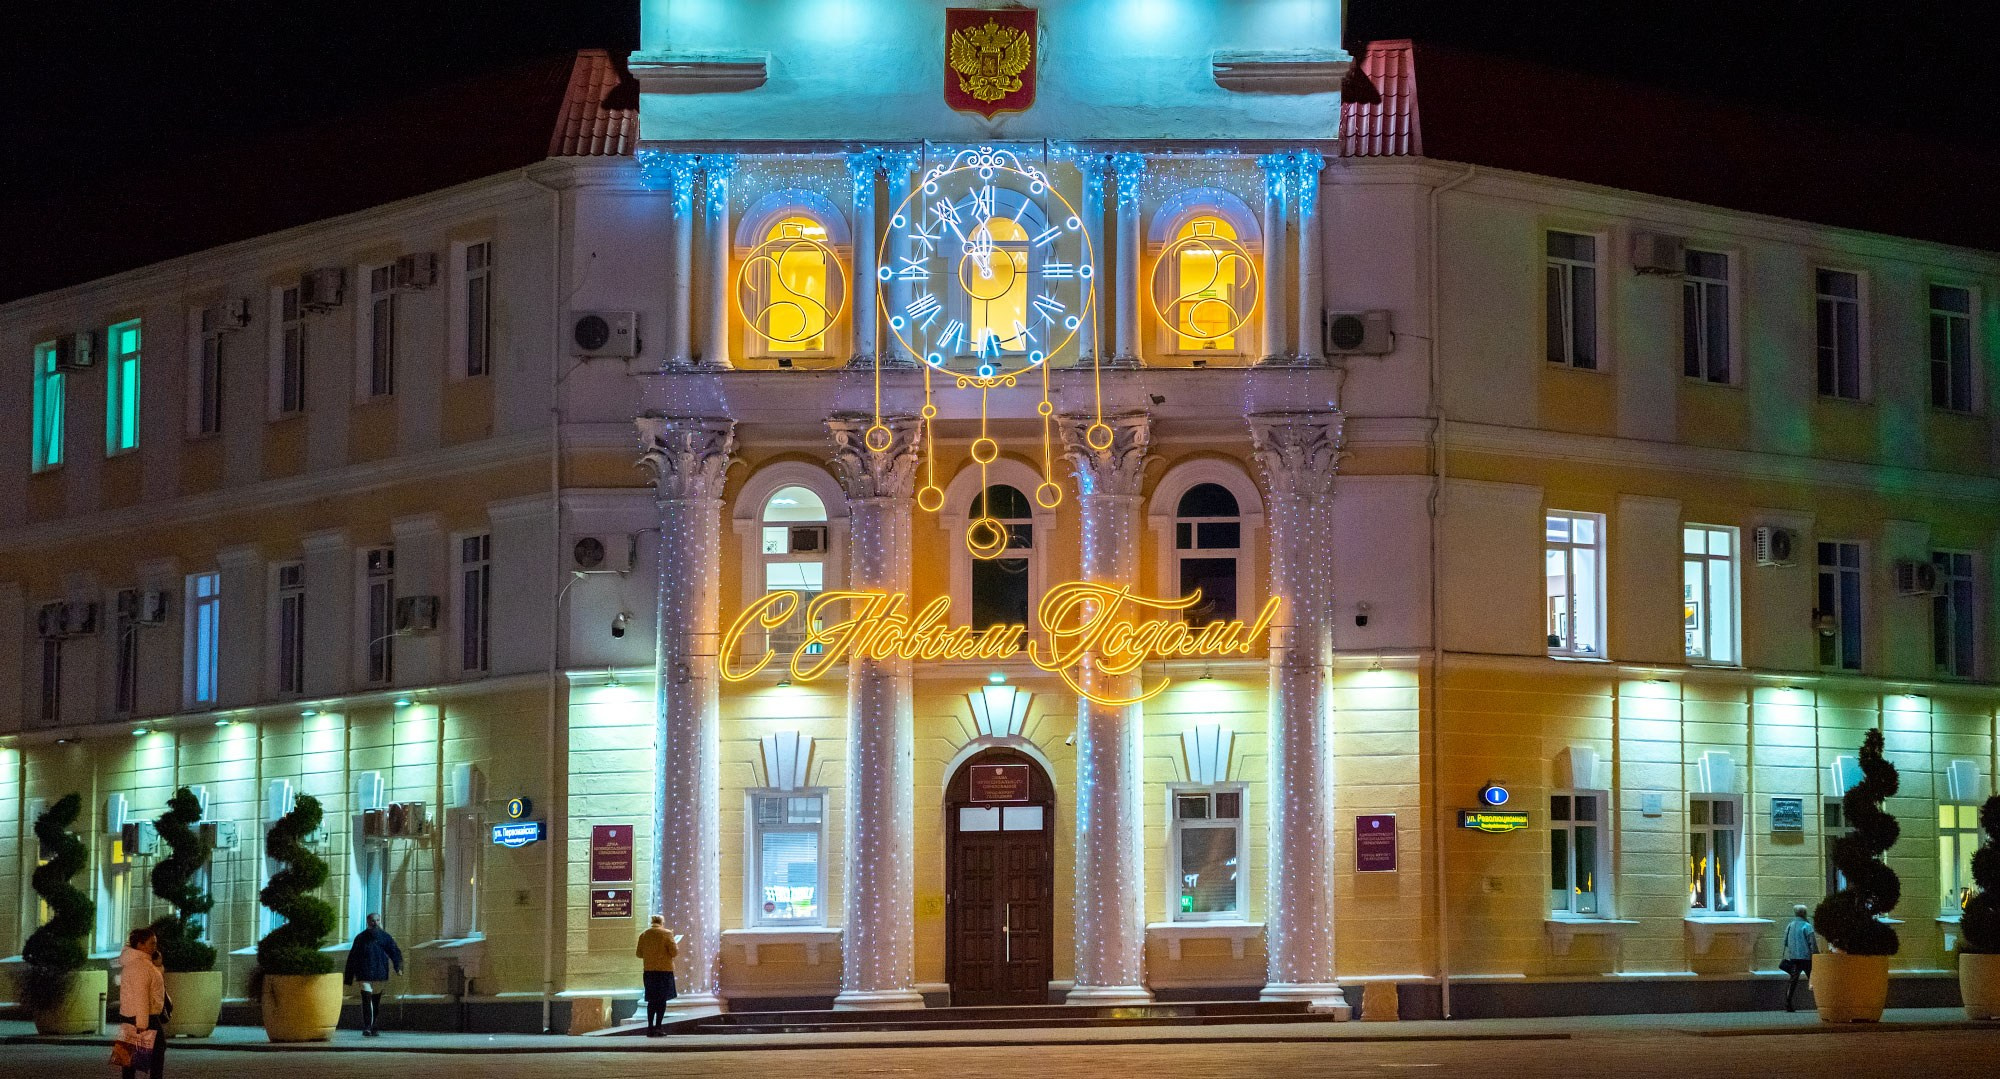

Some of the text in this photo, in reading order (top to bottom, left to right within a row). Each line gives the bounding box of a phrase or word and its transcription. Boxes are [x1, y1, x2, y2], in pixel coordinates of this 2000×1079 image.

[908, 223, 941, 251] X
[1032, 226, 1062, 247] II
[1042, 264, 1074, 278] III
[905, 293, 941, 330] VIII
[1033, 294, 1066, 324] IV
[937, 319, 963, 353] VII
[719, 581, 1282, 707] С Новым Годом!
[1466, 814, 1527, 824] ул. Революционная
